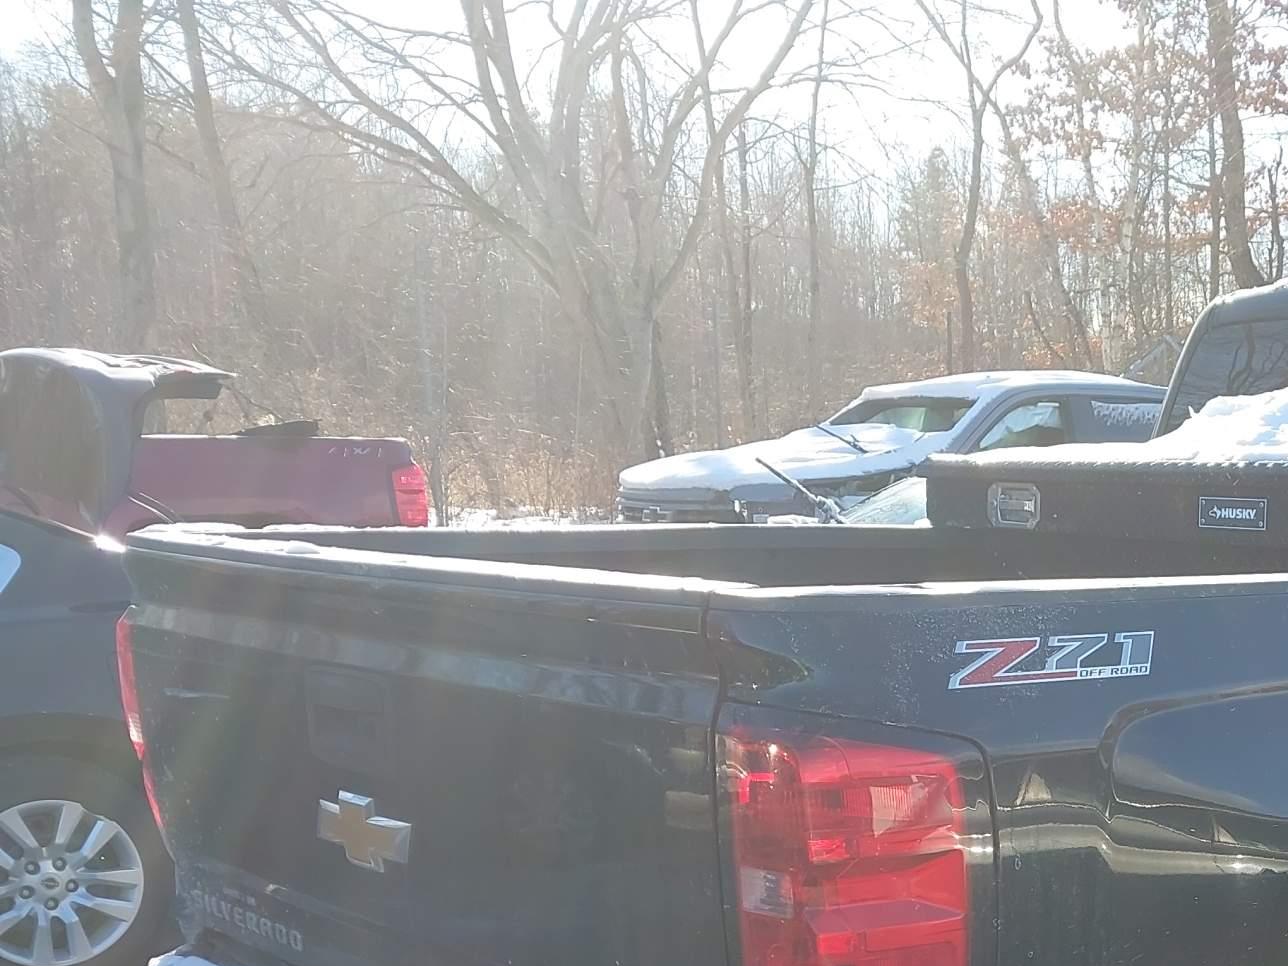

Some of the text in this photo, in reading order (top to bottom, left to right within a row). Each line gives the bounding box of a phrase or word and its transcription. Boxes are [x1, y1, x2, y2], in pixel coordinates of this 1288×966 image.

[1221, 507, 1257, 519] HUSKY
[948, 630, 1155, 689] Z71
[1079, 663, 1150, 679] OFF ROAD
